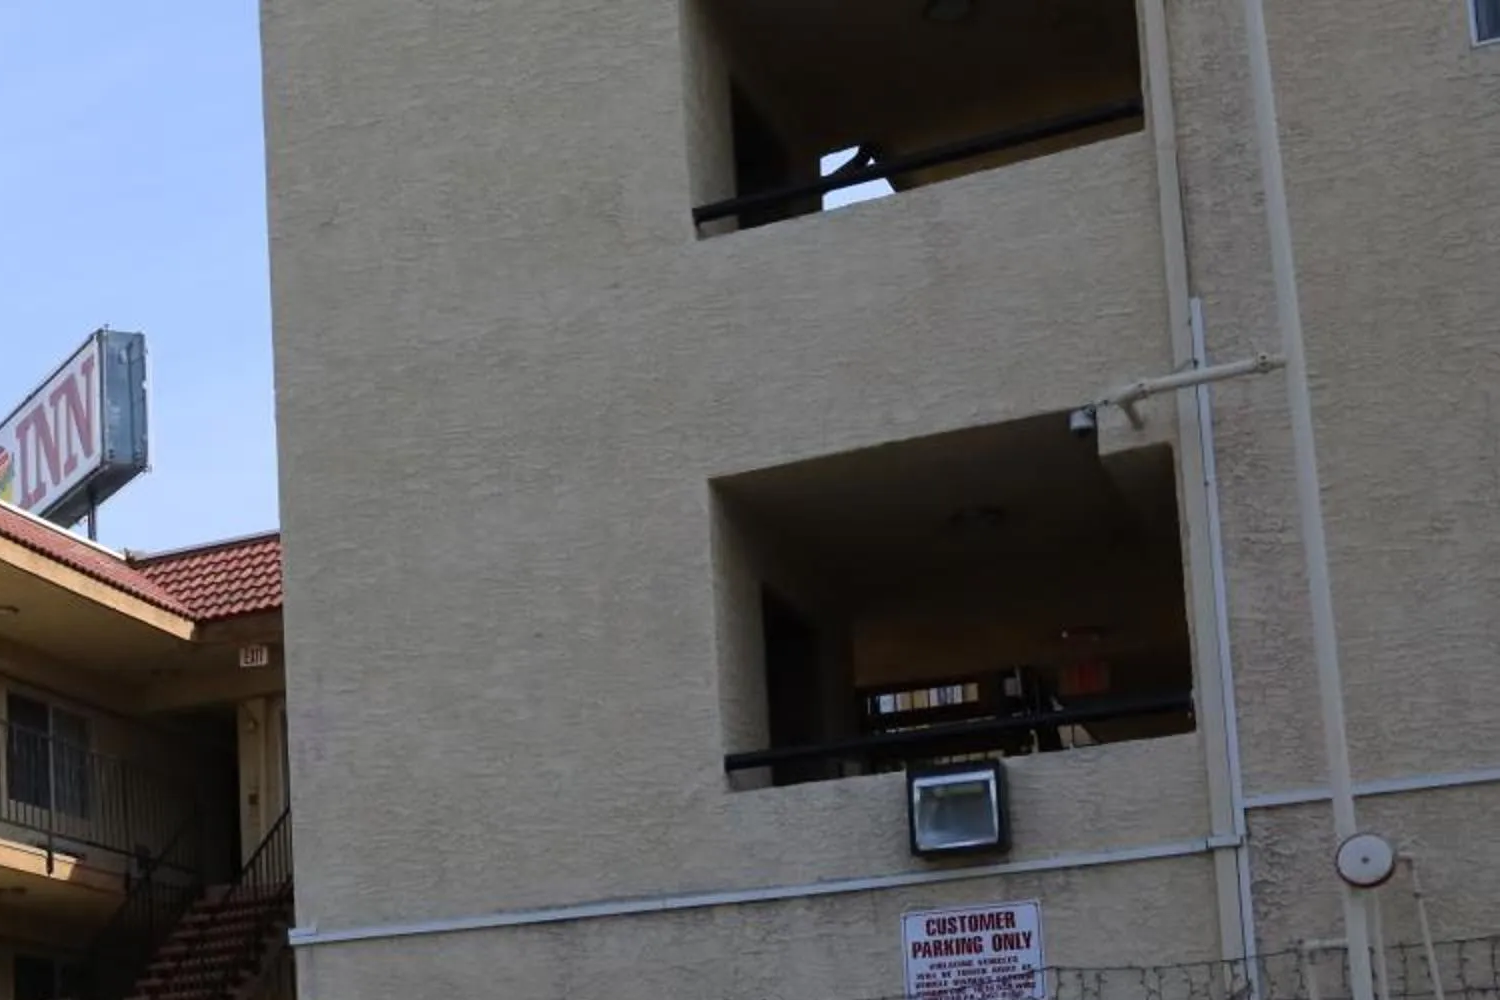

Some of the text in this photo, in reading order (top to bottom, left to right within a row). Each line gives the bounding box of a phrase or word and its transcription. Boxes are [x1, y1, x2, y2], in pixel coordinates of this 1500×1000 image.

[15, 355, 95, 510] INN
[926, 911, 1017, 936] CUSTOMER
[911, 931, 1033, 959] PARKING ONLY
